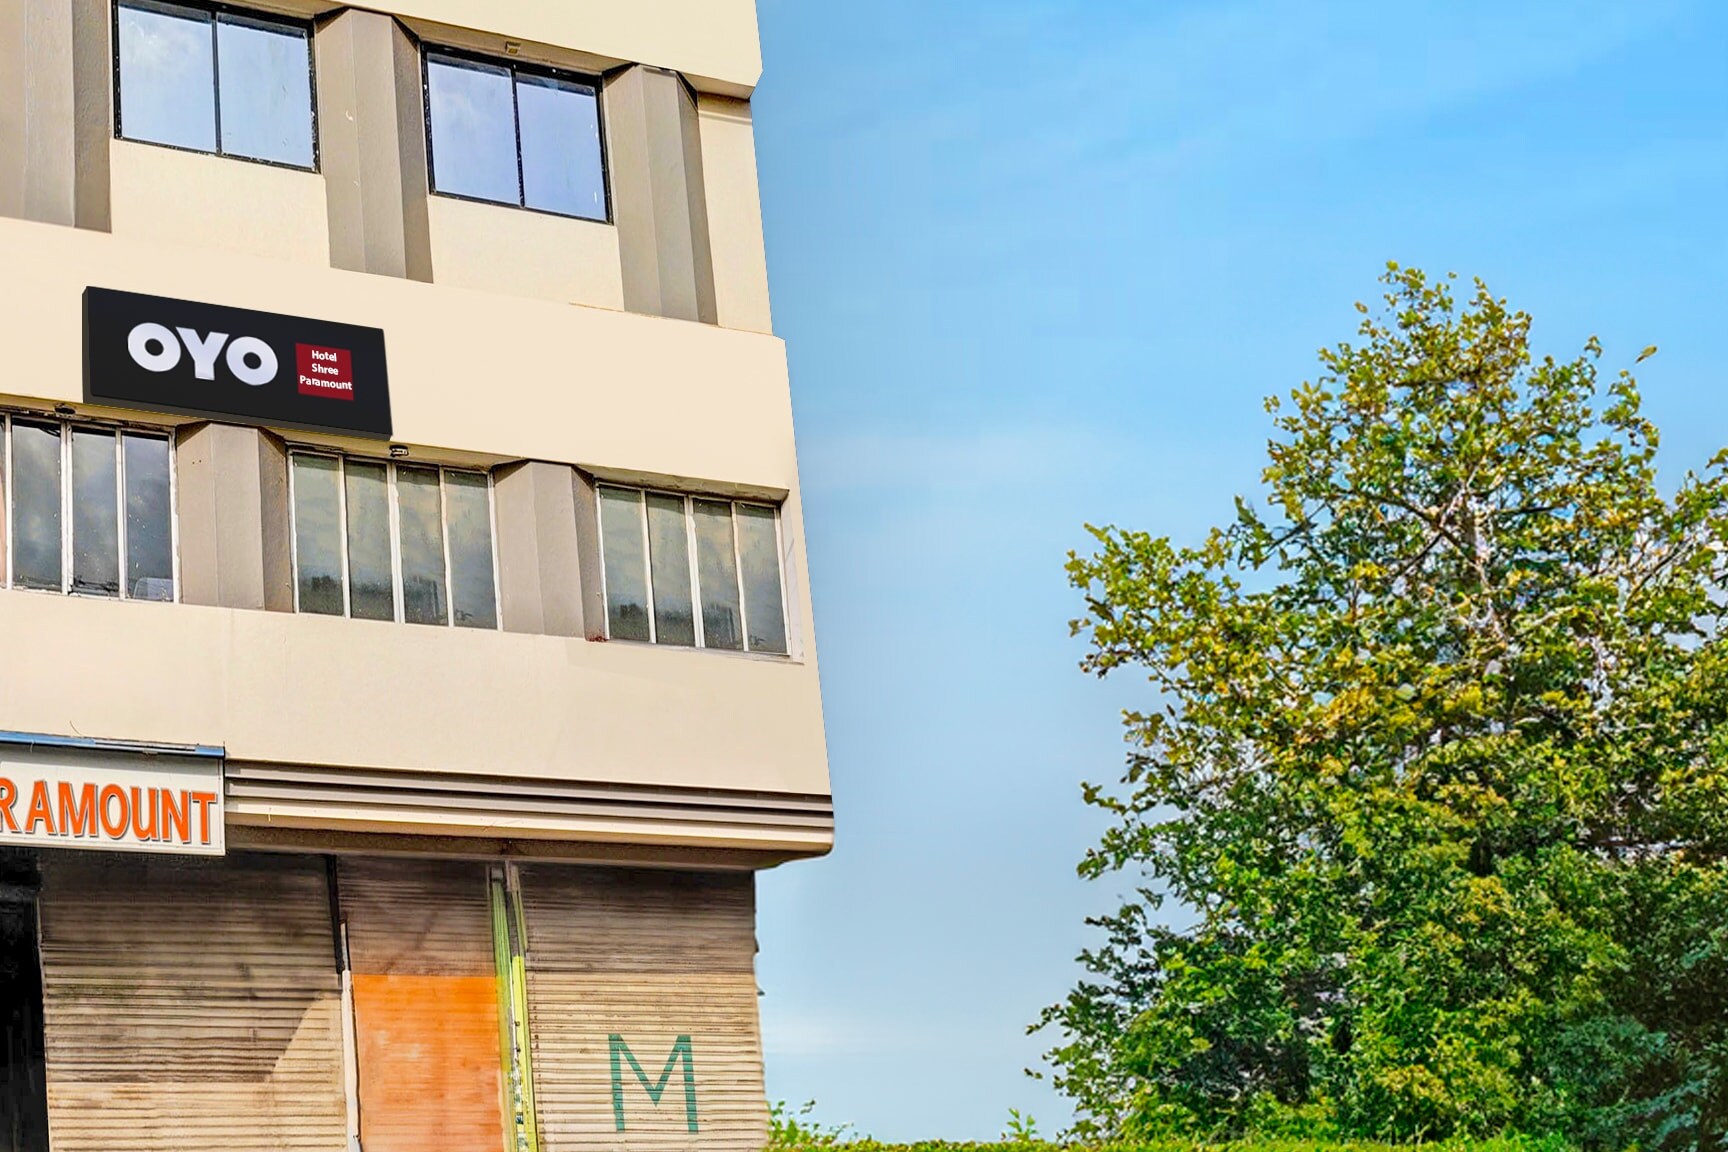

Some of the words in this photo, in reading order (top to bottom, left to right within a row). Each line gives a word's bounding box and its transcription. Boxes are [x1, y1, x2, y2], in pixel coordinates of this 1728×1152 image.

[127, 322, 279, 386] OYO
[311, 349, 338, 363] Hotel
[311, 363, 339, 376] Shree
[299, 374, 353, 391] Paramount
[607, 1033, 700, 1136] M
